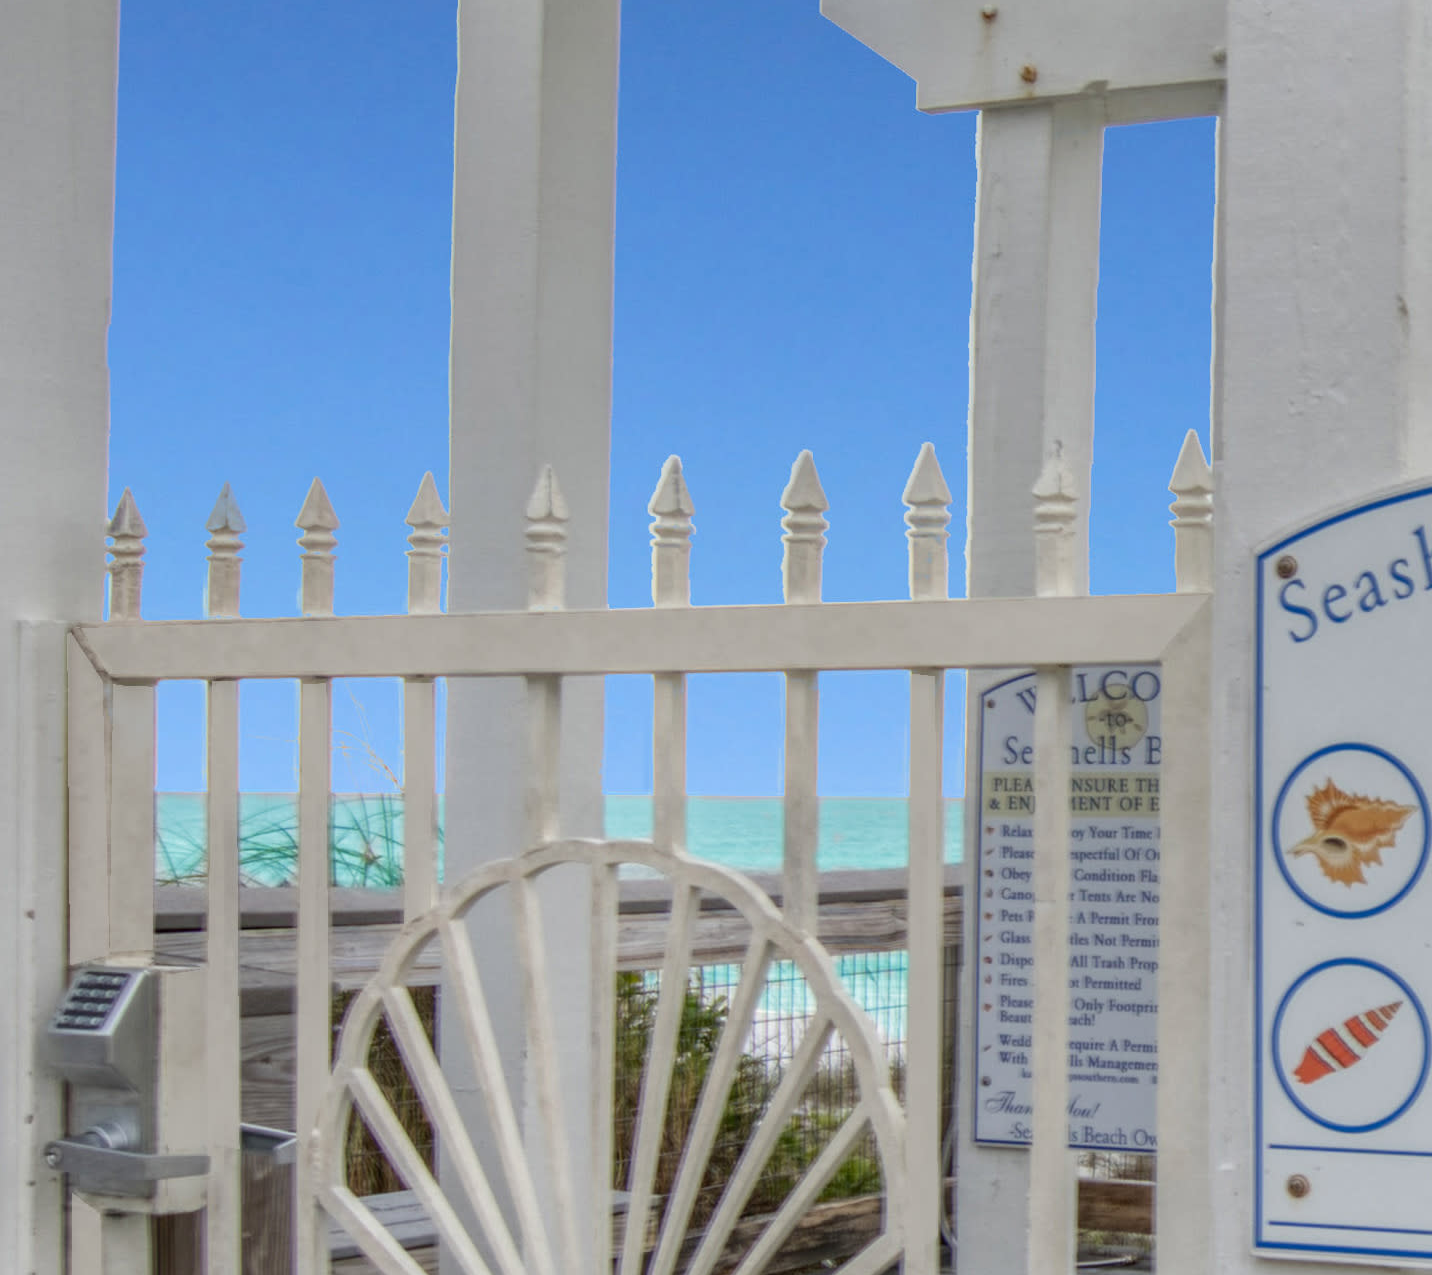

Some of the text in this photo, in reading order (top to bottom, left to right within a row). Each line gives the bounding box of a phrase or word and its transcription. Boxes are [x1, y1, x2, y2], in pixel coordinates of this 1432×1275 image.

[992, 777, 1034, 793] PLEA
[1071, 777, 1129, 793] NSURE
[989, 797, 1001, 811] &
[1119, 795, 1144, 812] OF
[1088, 826, 1118, 840] Your
[1121, 826, 1153, 840] Time
[1070, 847, 1120, 862] espectful
[1124, 848, 1141, 861] Of
[1000, 867, 1033, 881] Obey
[1073, 869, 1136, 883] Condition
[1078, 889, 1112, 903] Tents
[1115, 890, 1137, 903] Are
[1000, 909, 1024, 923] Pets
[1077, 912, 1087, 924] A
[1090, 911, 1131, 926] Permit
[1000, 930, 1032, 944] Glass
[1094, 934, 1118, 947] Not
[1070, 955, 1088, 969] All
[1092, 955, 1126, 970] Trash
[1000, 973, 1028, 987] Fires
[1084, 976, 1142, 991] Permitted
[1074, 998, 1105, 1015] Only
[1069, 1039, 1106, 1054] equire
[1109, 1039, 1120, 1052] A
[998, 1051, 1029, 1065] With
[1084, 1125, 1128, 1145] Beach
